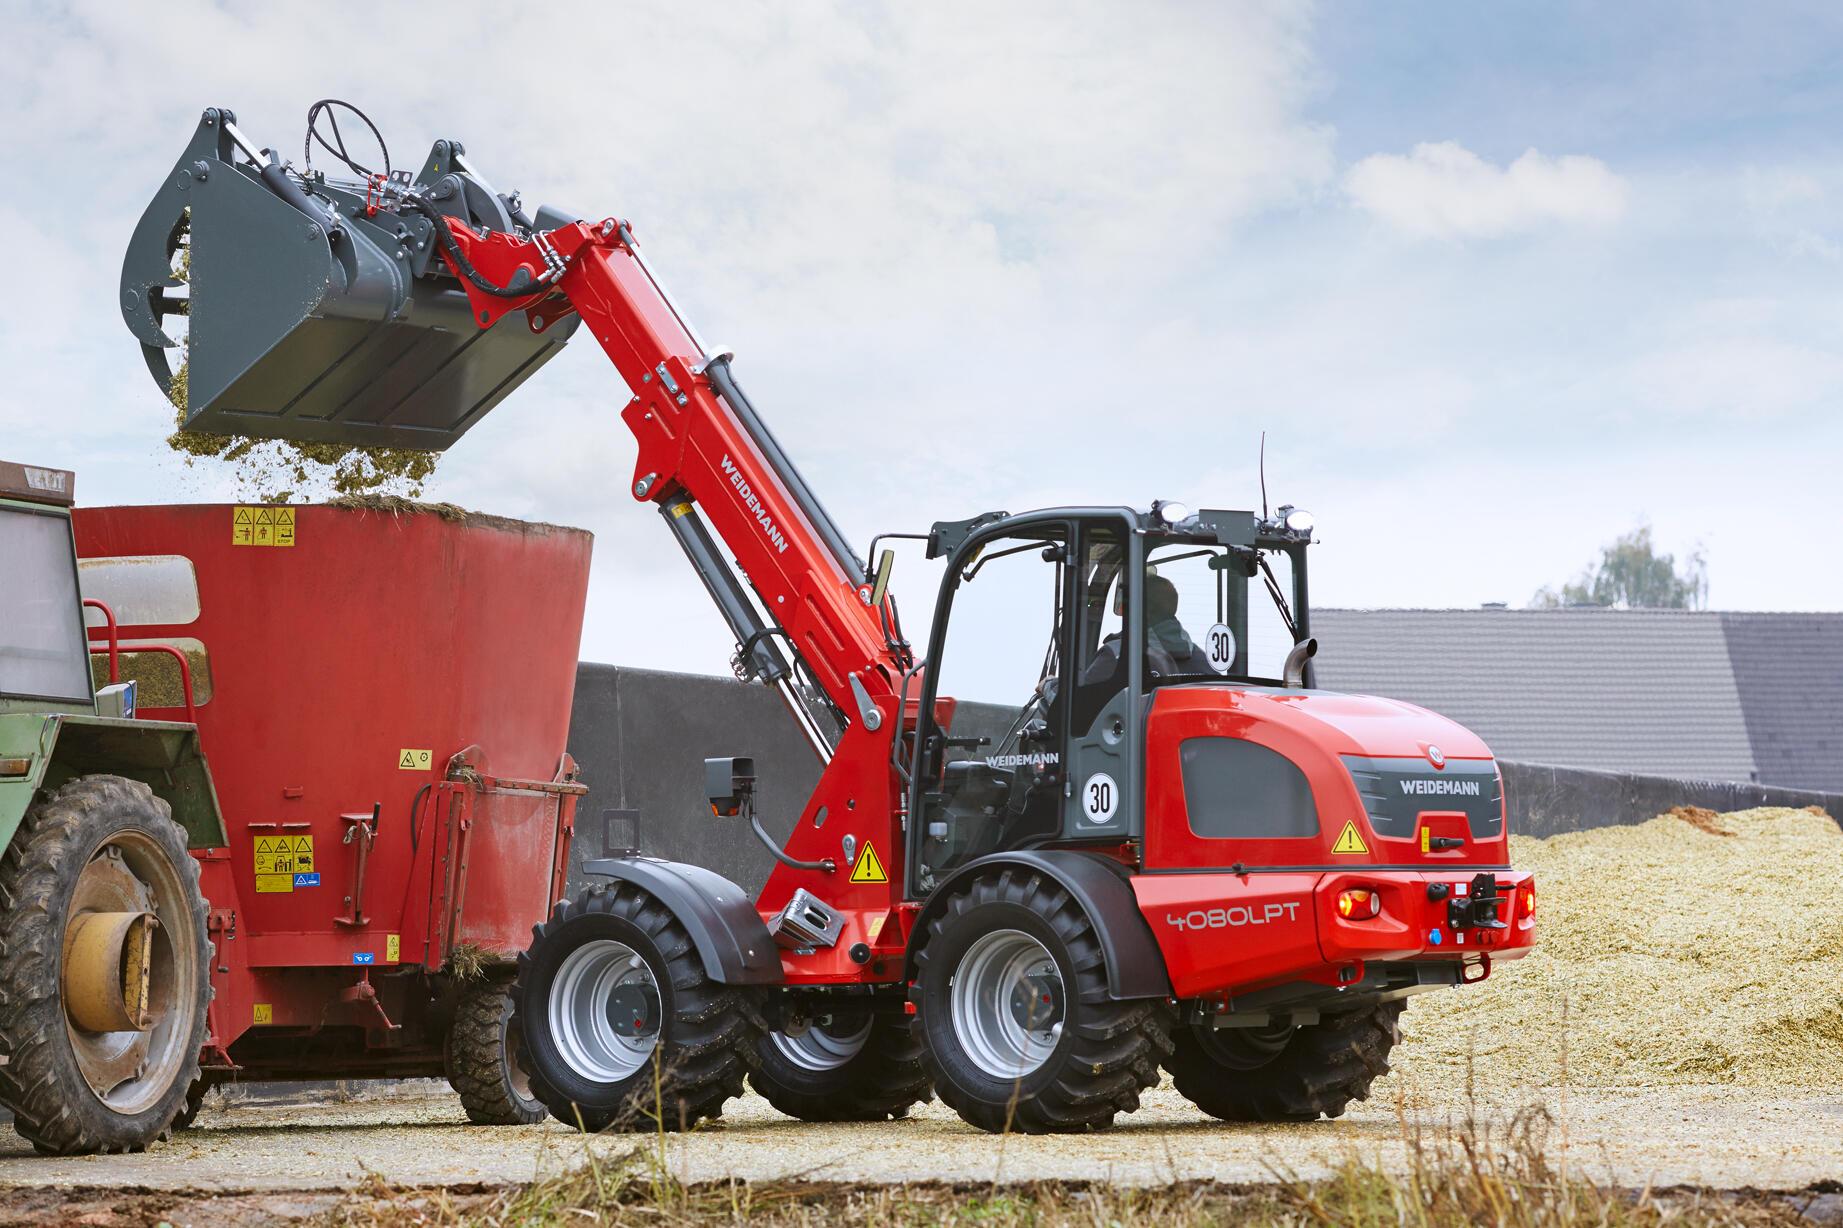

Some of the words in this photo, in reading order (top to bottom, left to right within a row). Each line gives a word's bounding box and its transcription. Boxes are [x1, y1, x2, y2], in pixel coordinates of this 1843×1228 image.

[721, 453, 788, 554] WEIDEMANN
[1211, 632, 1229, 662] 30
[985, 752, 1059, 767] WEIDEMANN
[1090, 782, 1110, 814] 30
[1400, 780, 1480, 796] WEIDEMANN
[1166, 901, 1300, 931] 4080LPT
